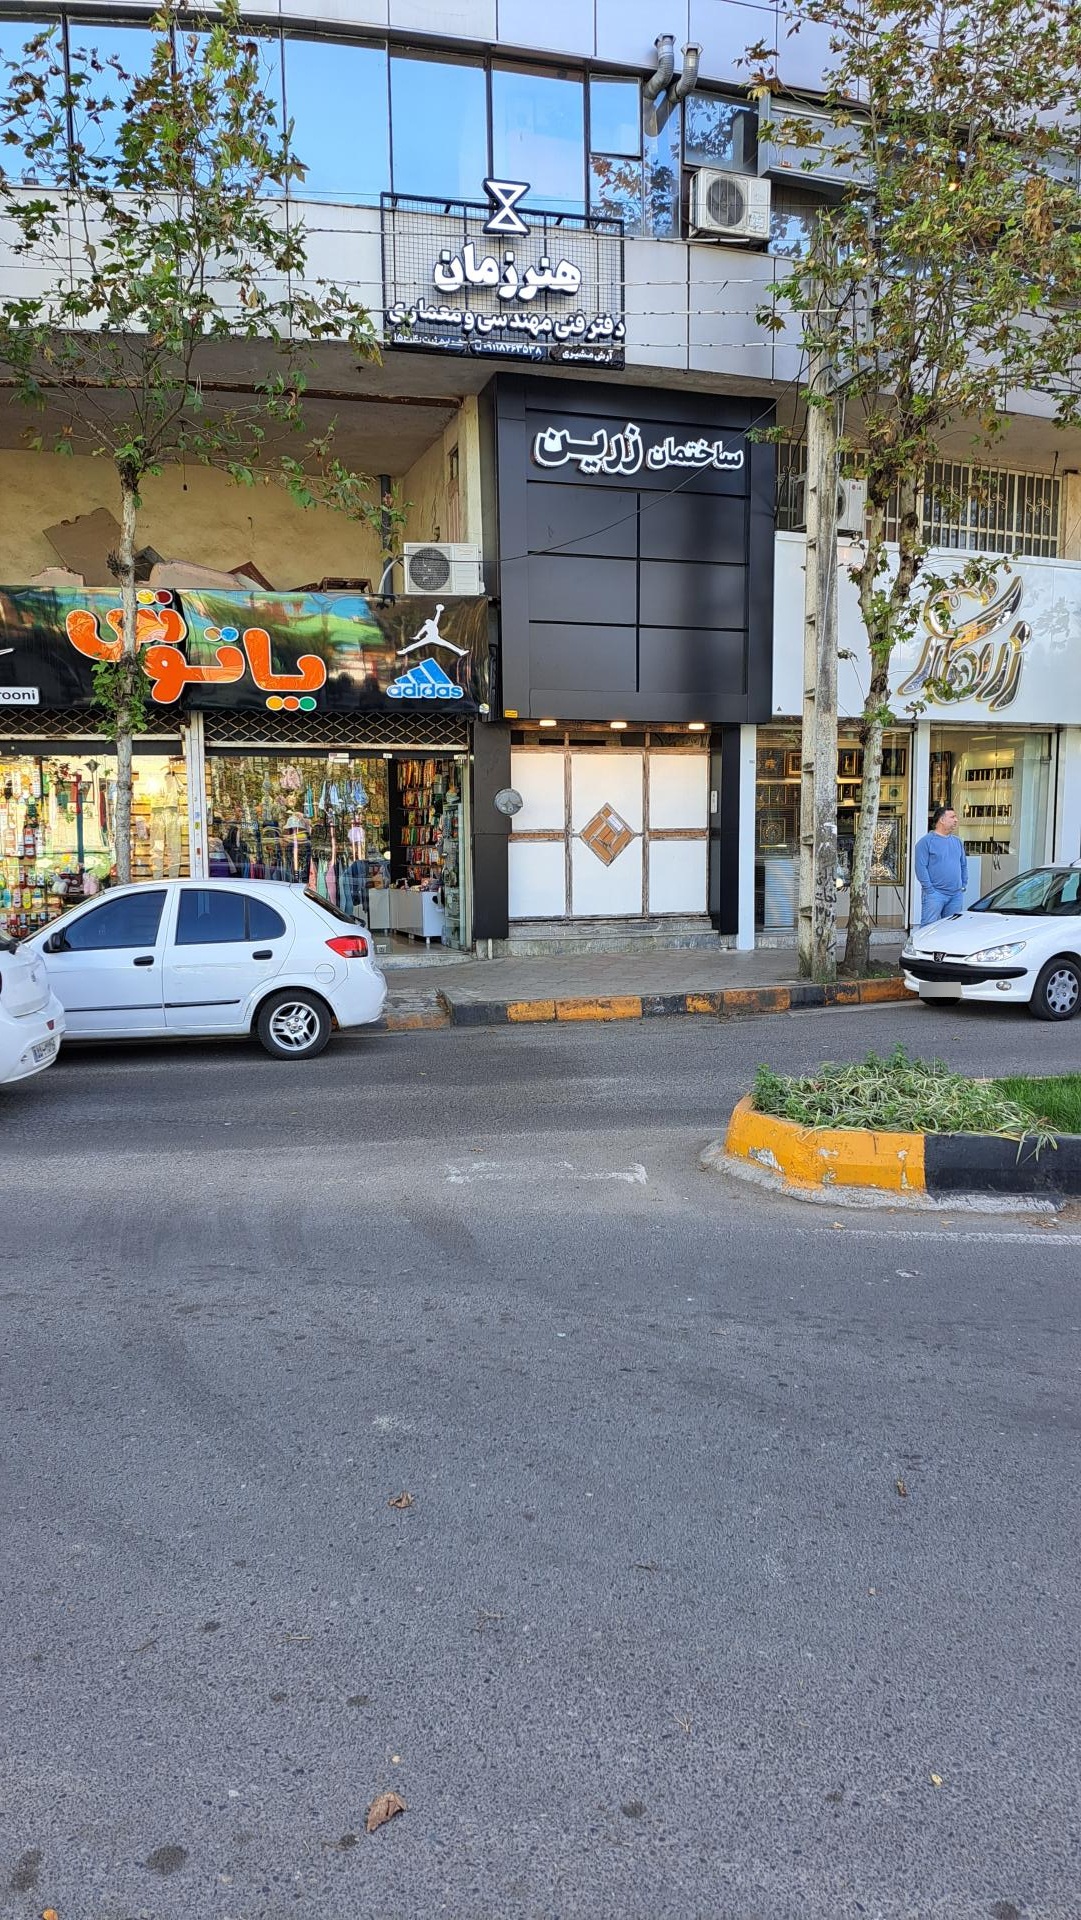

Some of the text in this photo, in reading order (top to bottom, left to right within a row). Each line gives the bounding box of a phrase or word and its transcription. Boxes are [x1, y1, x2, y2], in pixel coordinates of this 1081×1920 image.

[387, 298, 626, 341] دفتر فنی مهندسی و معماری
[562, 349, 614, 362] آرش مشیری
[533, 422, 744, 475] ساختمان زرین
[387, 683, 463, 698] adidas
